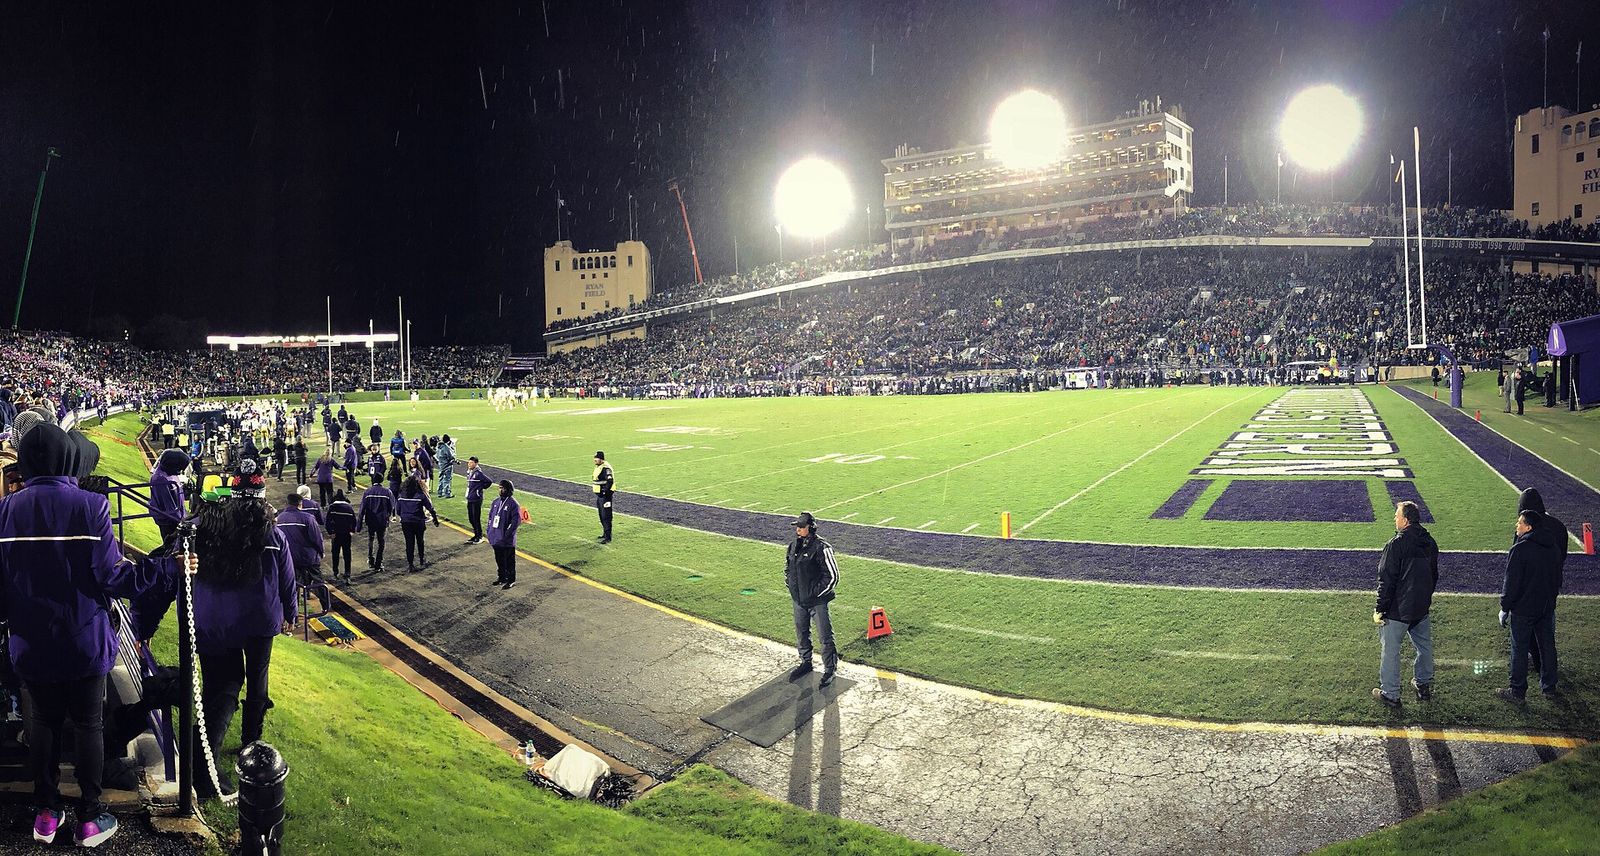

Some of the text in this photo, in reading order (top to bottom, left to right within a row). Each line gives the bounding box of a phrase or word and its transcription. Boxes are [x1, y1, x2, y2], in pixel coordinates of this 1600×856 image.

[1413, 239, 1427, 248] 190
[1431, 240, 1444, 248] 1931
[1448, 240, 1463, 249] 1936
[1468, 241, 1483, 249] 1995
[1487, 241, 1503, 250] 1996
[1507, 242, 1526, 250] 2000
[584, 290, 606, 298] FIELD
[1360, 368, 1367, 378] N
[1189, 387, 1415, 478] WESTERN
[872, 611, 885, 630] G
